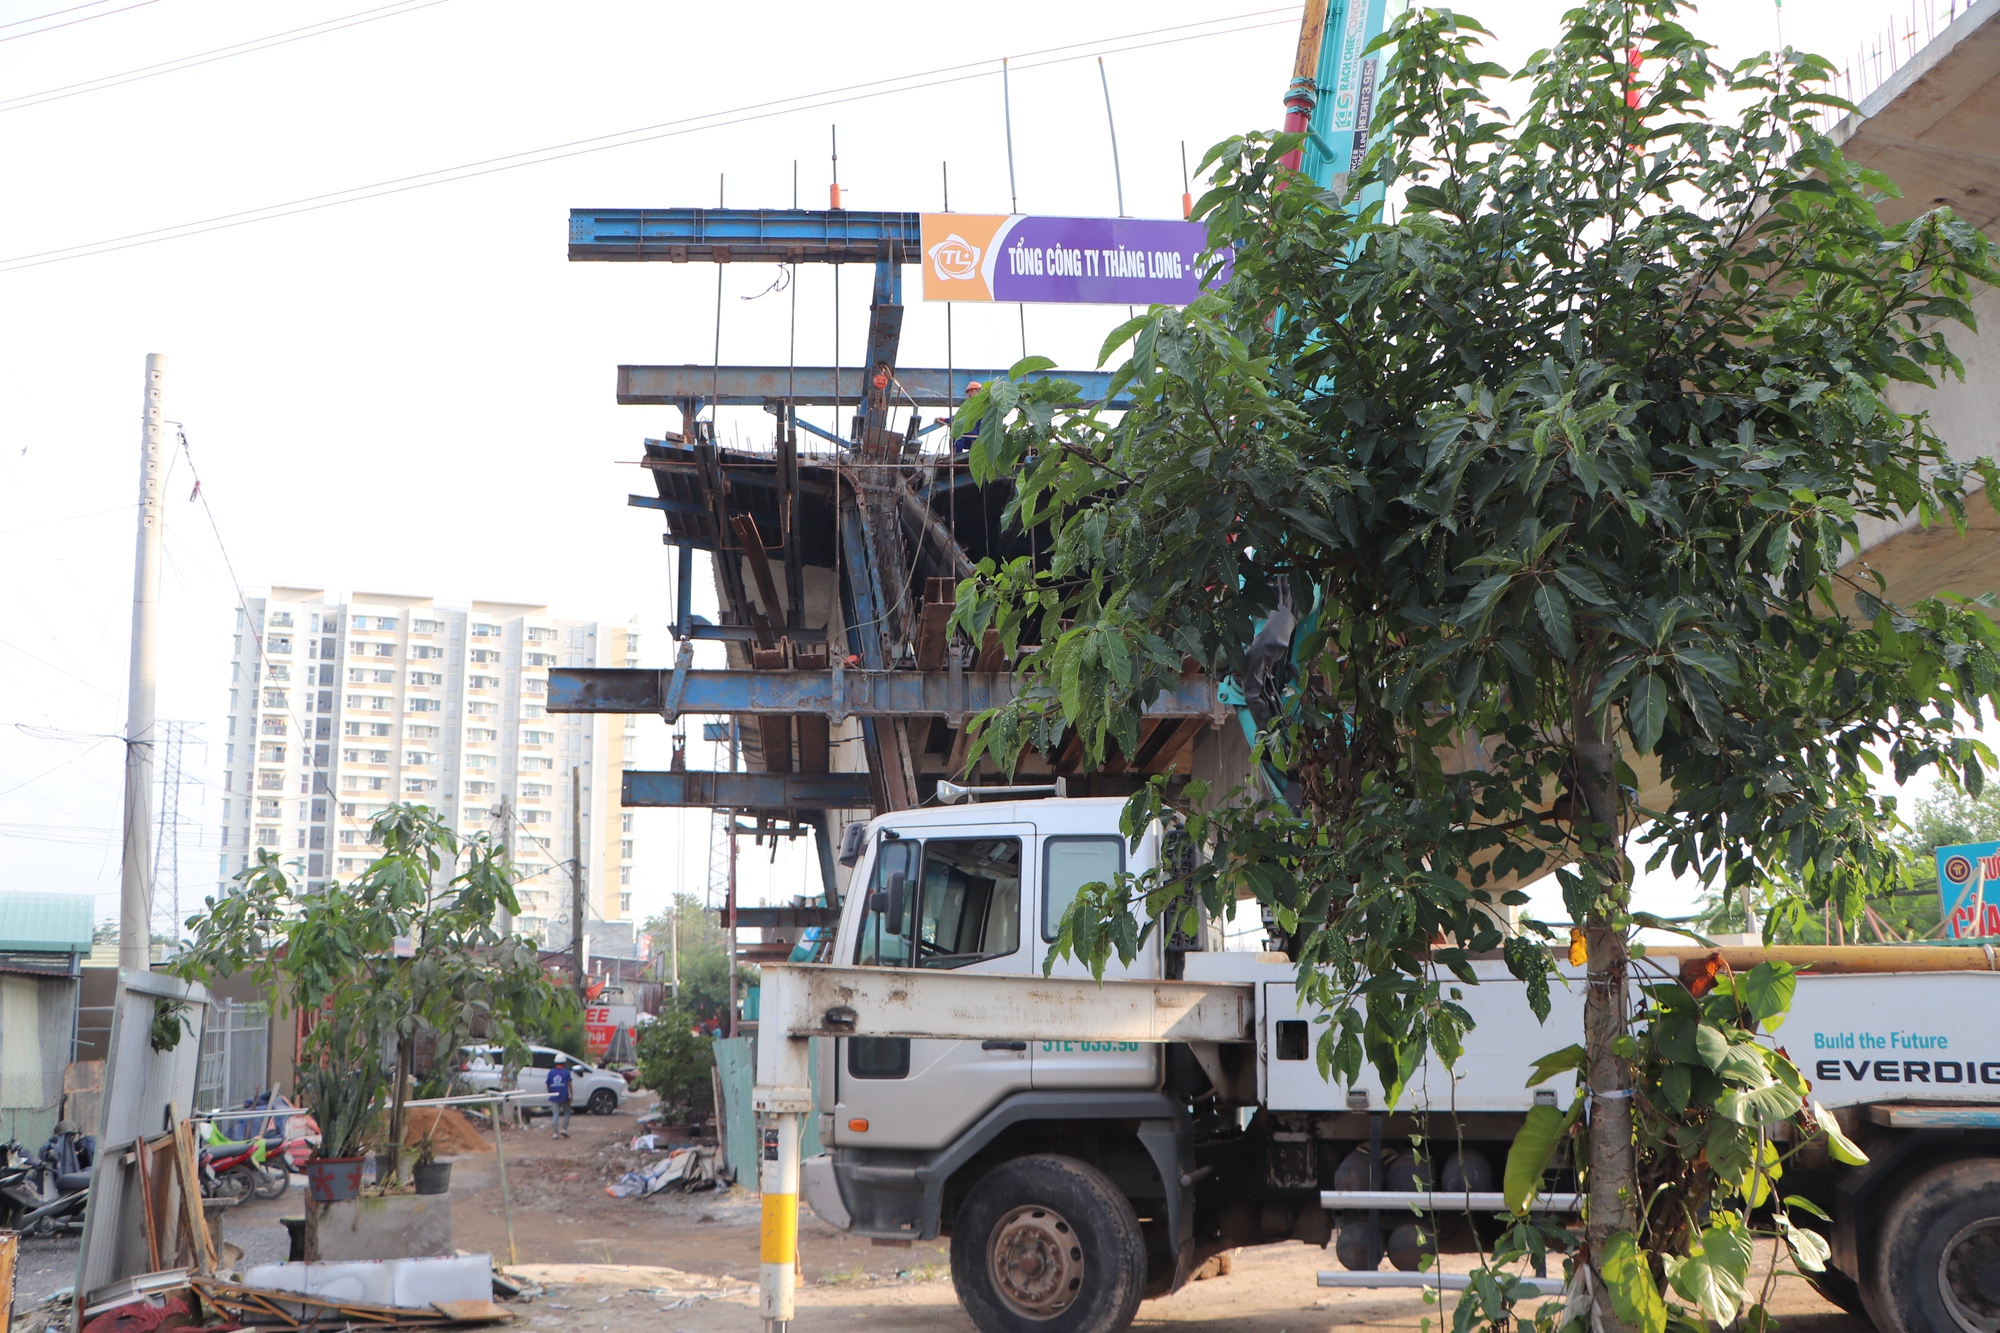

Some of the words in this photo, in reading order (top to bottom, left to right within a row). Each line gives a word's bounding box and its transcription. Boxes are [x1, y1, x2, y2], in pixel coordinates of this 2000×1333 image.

[1008, 236, 1044, 276] TỔNG
[1046, 242, 1082, 277] CÔNG
[1084, 249, 1099, 277] TY
[1102, 244, 1145, 278] THĂNG
[1148, 251, 1182, 279] LONG
[1814, 1032, 1855, 1049] Build
[1859, 1032, 1886, 1049] the
[1890, 1031, 1948, 1049] Future
[1816, 1059, 2000, 1085] EVERDIG
